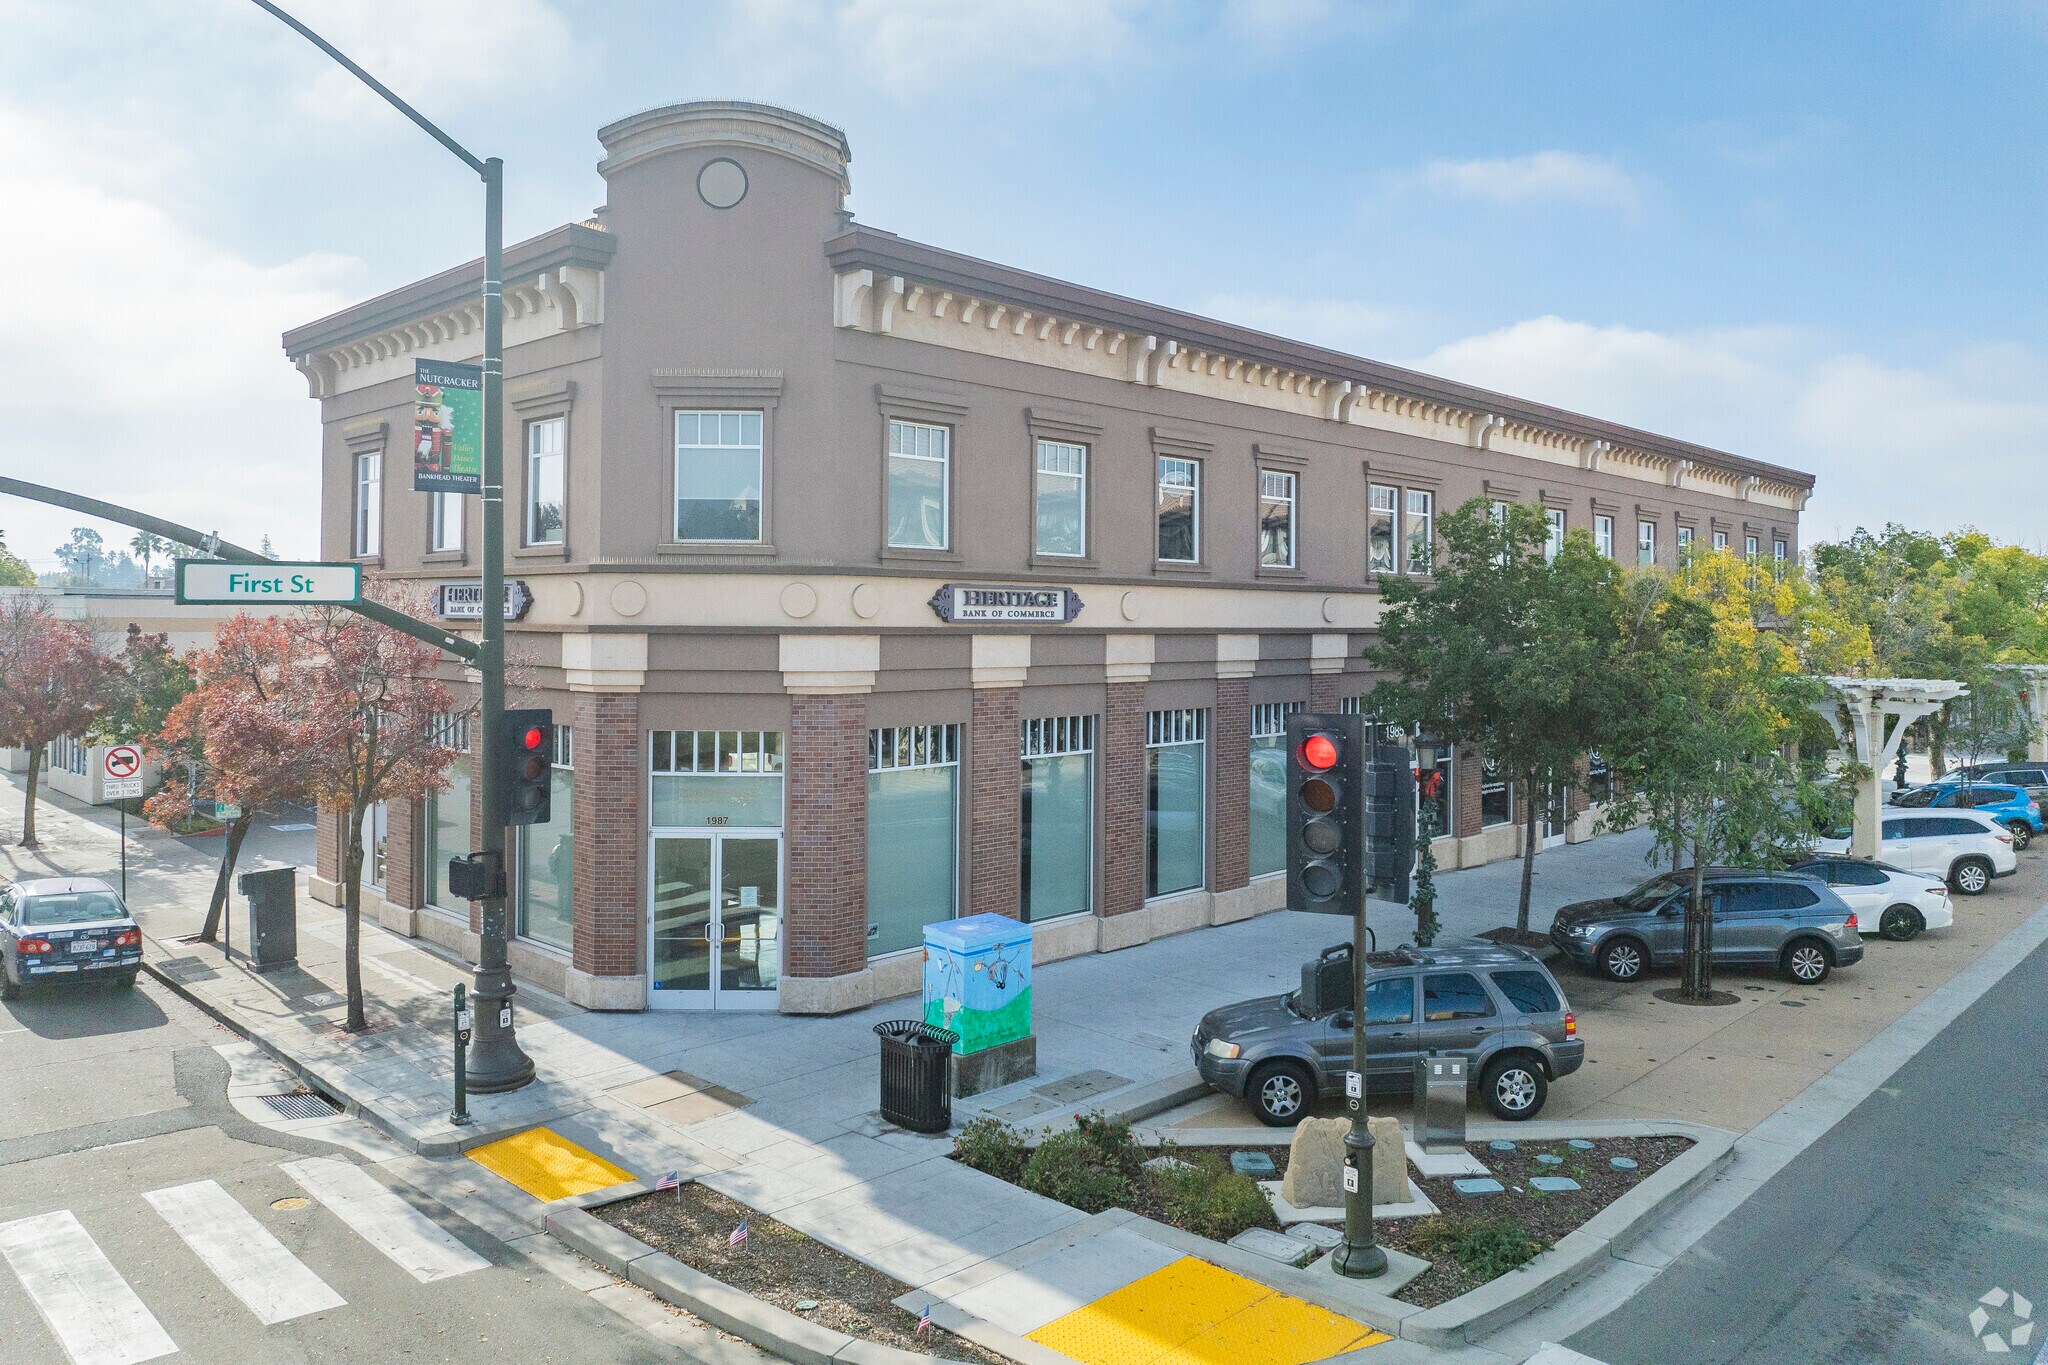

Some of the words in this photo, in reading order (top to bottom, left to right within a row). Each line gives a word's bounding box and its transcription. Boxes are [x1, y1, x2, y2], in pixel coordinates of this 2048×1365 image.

[420, 373, 478, 388] NUTCRACKER
[418, 473, 451, 481] BANKHEAD
[452, 474, 477, 482] THEATER
[229, 573, 283, 593] First
[290, 574, 315, 593] St
[963, 590, 1058, 607] HERITAGE
[962, 609, 987, 617] BANK
[992, 609, 1003, 617] OF
[1007, 610, 1055, 618] COMMERCE
[706, 816, 729, 825] 1987
